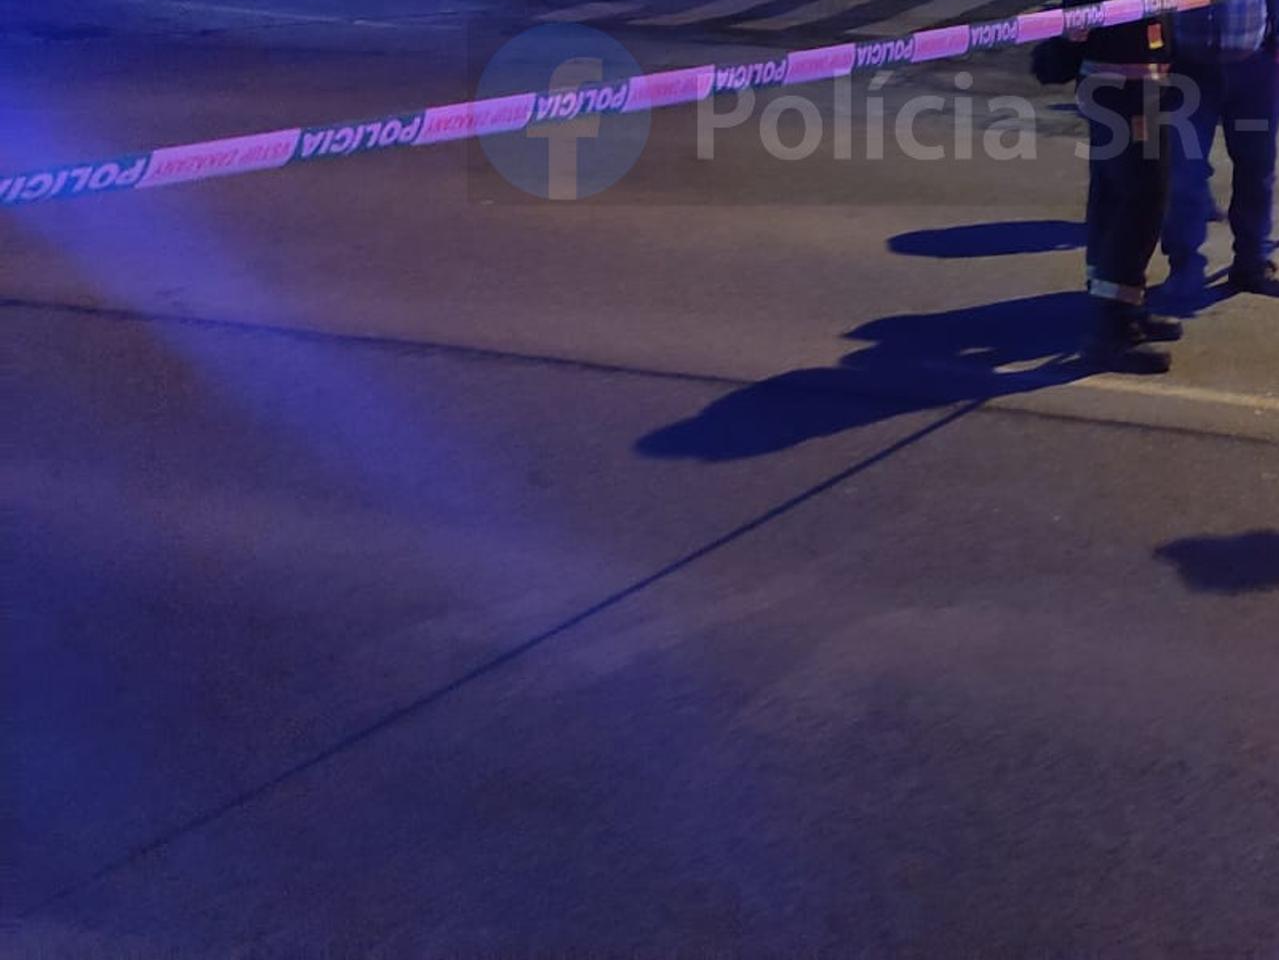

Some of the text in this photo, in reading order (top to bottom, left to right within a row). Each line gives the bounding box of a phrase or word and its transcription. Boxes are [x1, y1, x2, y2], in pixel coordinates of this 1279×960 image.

[856, 38, 914, 66] POLÍCIA
[717, 59, 787, 89] POLÍCIA
[536, 87, 628, 121] POLÍCIA
[302, 117, 420, 156] POLÍCIA
